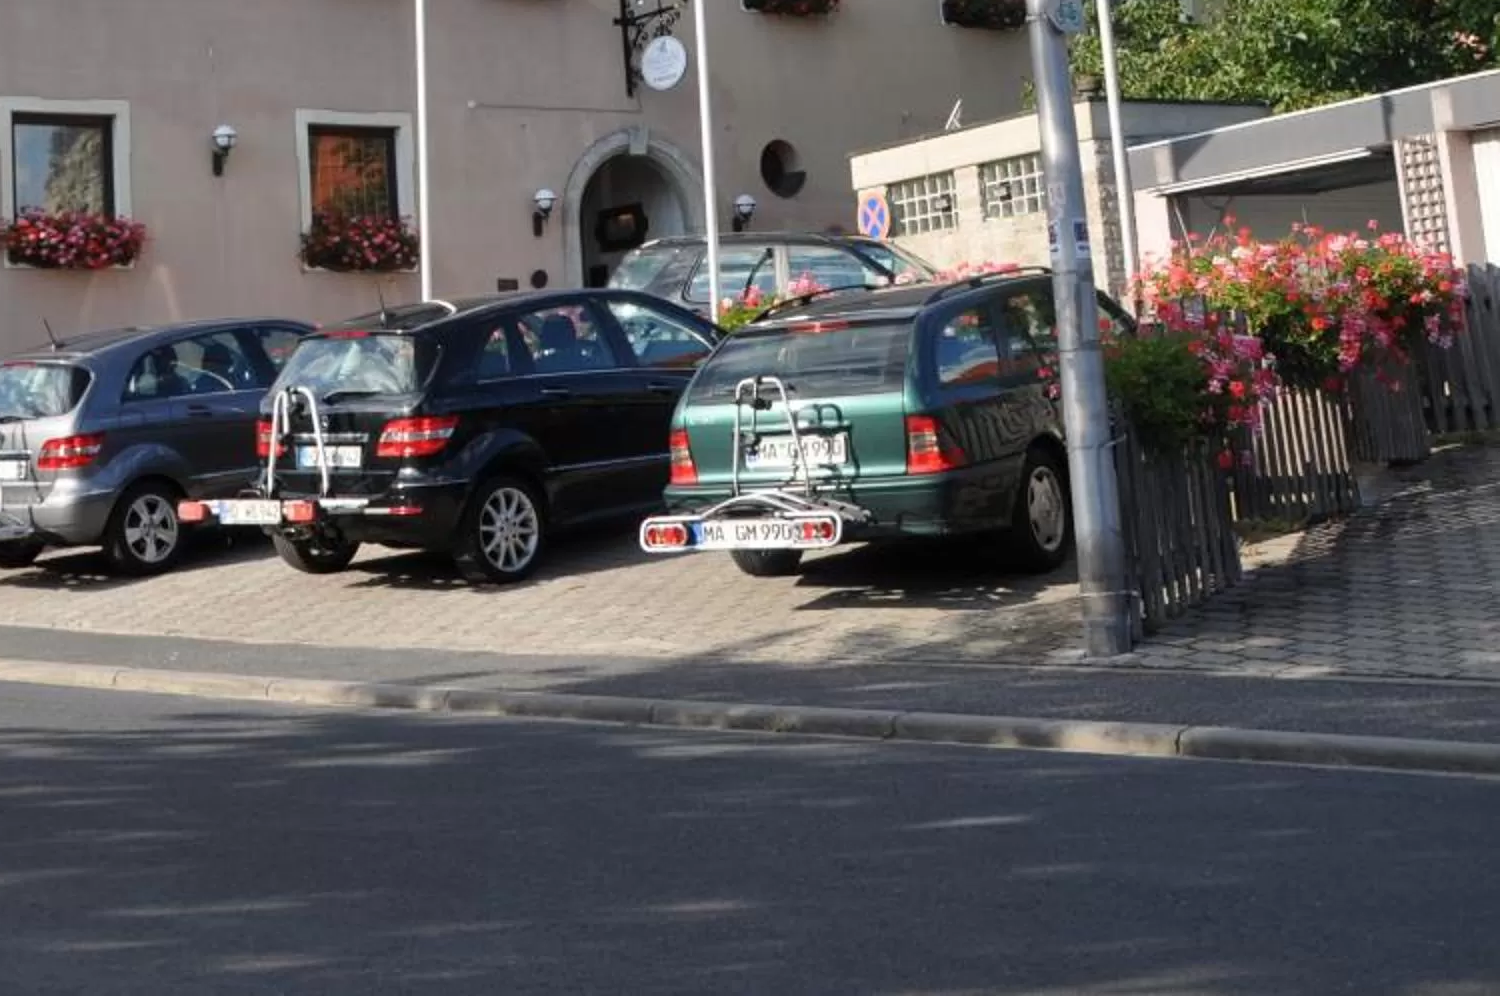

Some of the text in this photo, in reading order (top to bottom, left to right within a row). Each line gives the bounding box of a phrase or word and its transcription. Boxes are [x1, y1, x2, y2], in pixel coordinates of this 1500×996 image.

[703, 523, 792, 541] MA GM 990
